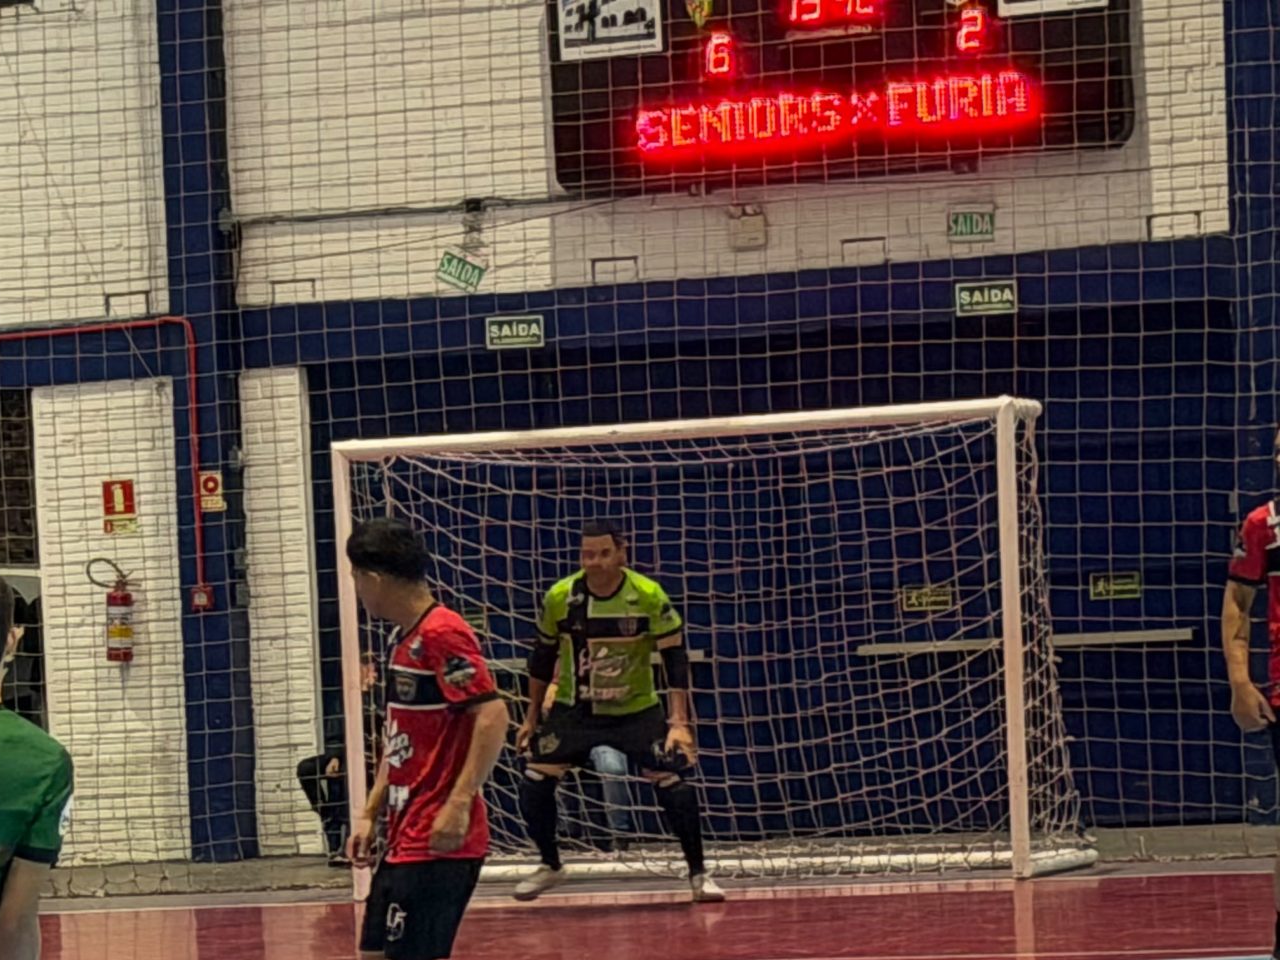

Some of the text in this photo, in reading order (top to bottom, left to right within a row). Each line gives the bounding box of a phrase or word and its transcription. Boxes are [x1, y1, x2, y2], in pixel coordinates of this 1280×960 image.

[957, 9, 985, 49] 2
[706, 34, 731, 74] 6
[636, 93, 842, 150] SENIORS
[887, 72, 1028, 126] FURIA
